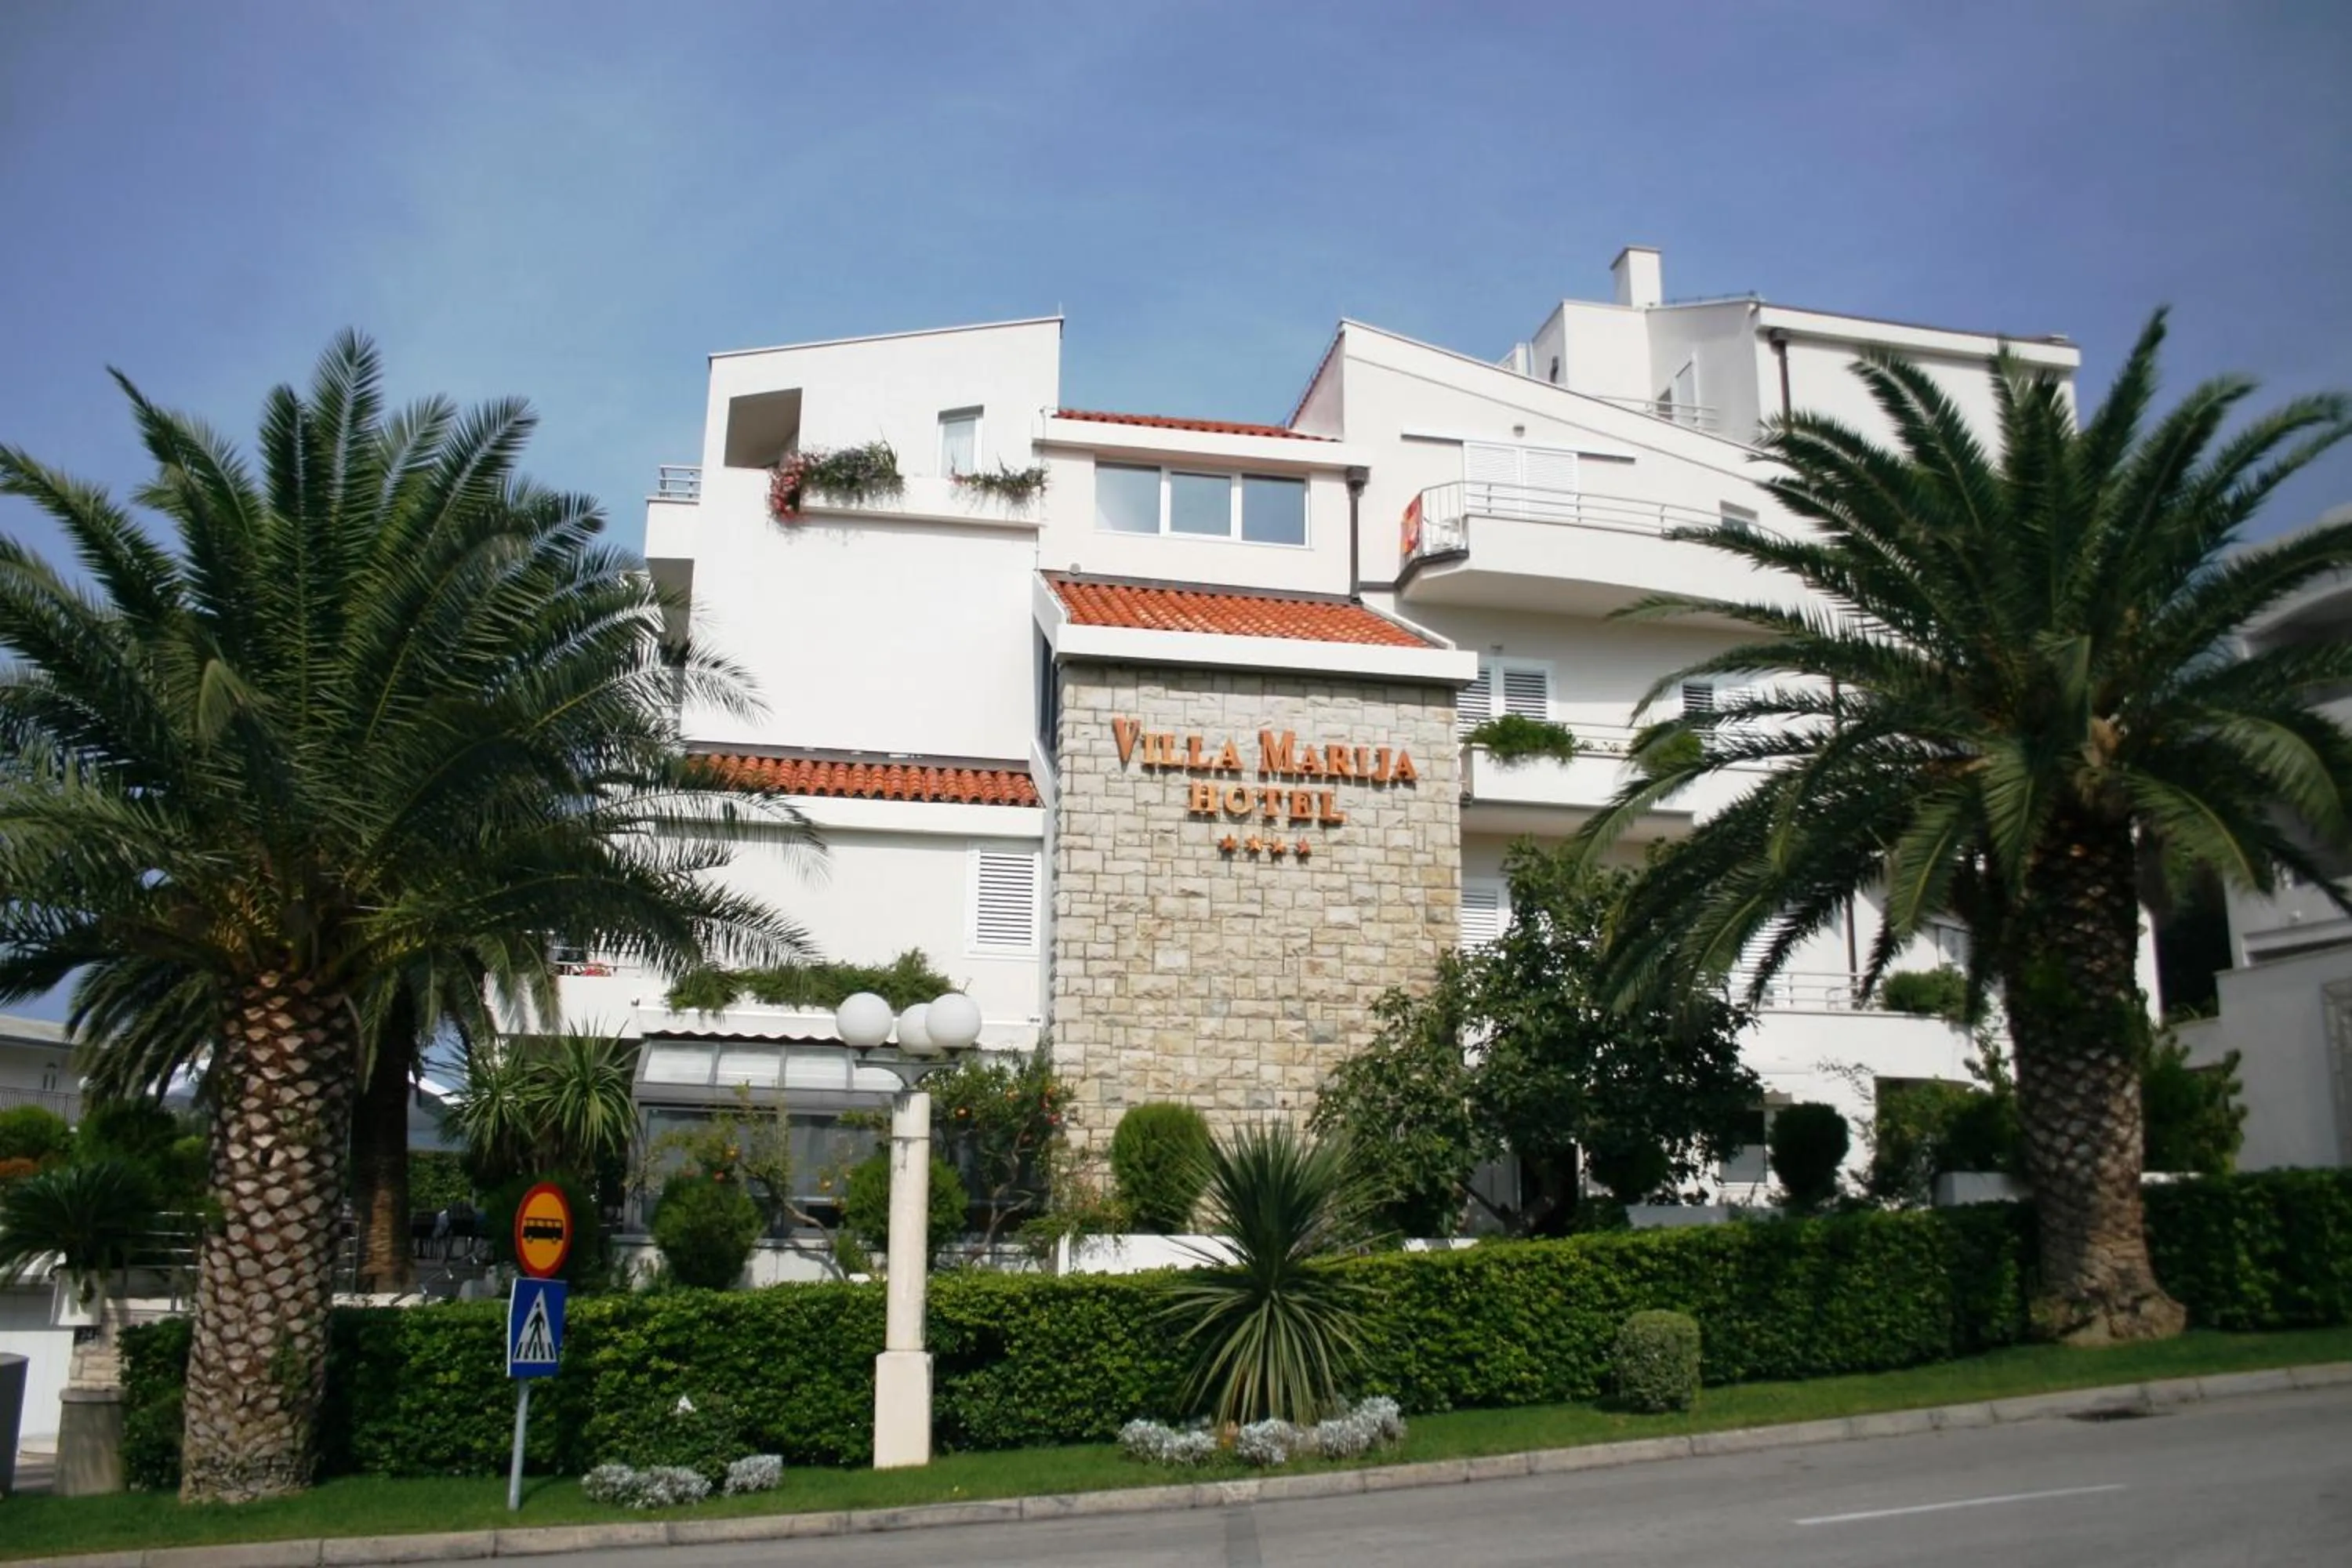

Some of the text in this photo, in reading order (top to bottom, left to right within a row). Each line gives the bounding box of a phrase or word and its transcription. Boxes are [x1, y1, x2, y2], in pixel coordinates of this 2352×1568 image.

[1112, 717, 1418, 782] VILLA MARIJA
[1189, 779, 1348, 822] HOTEL
